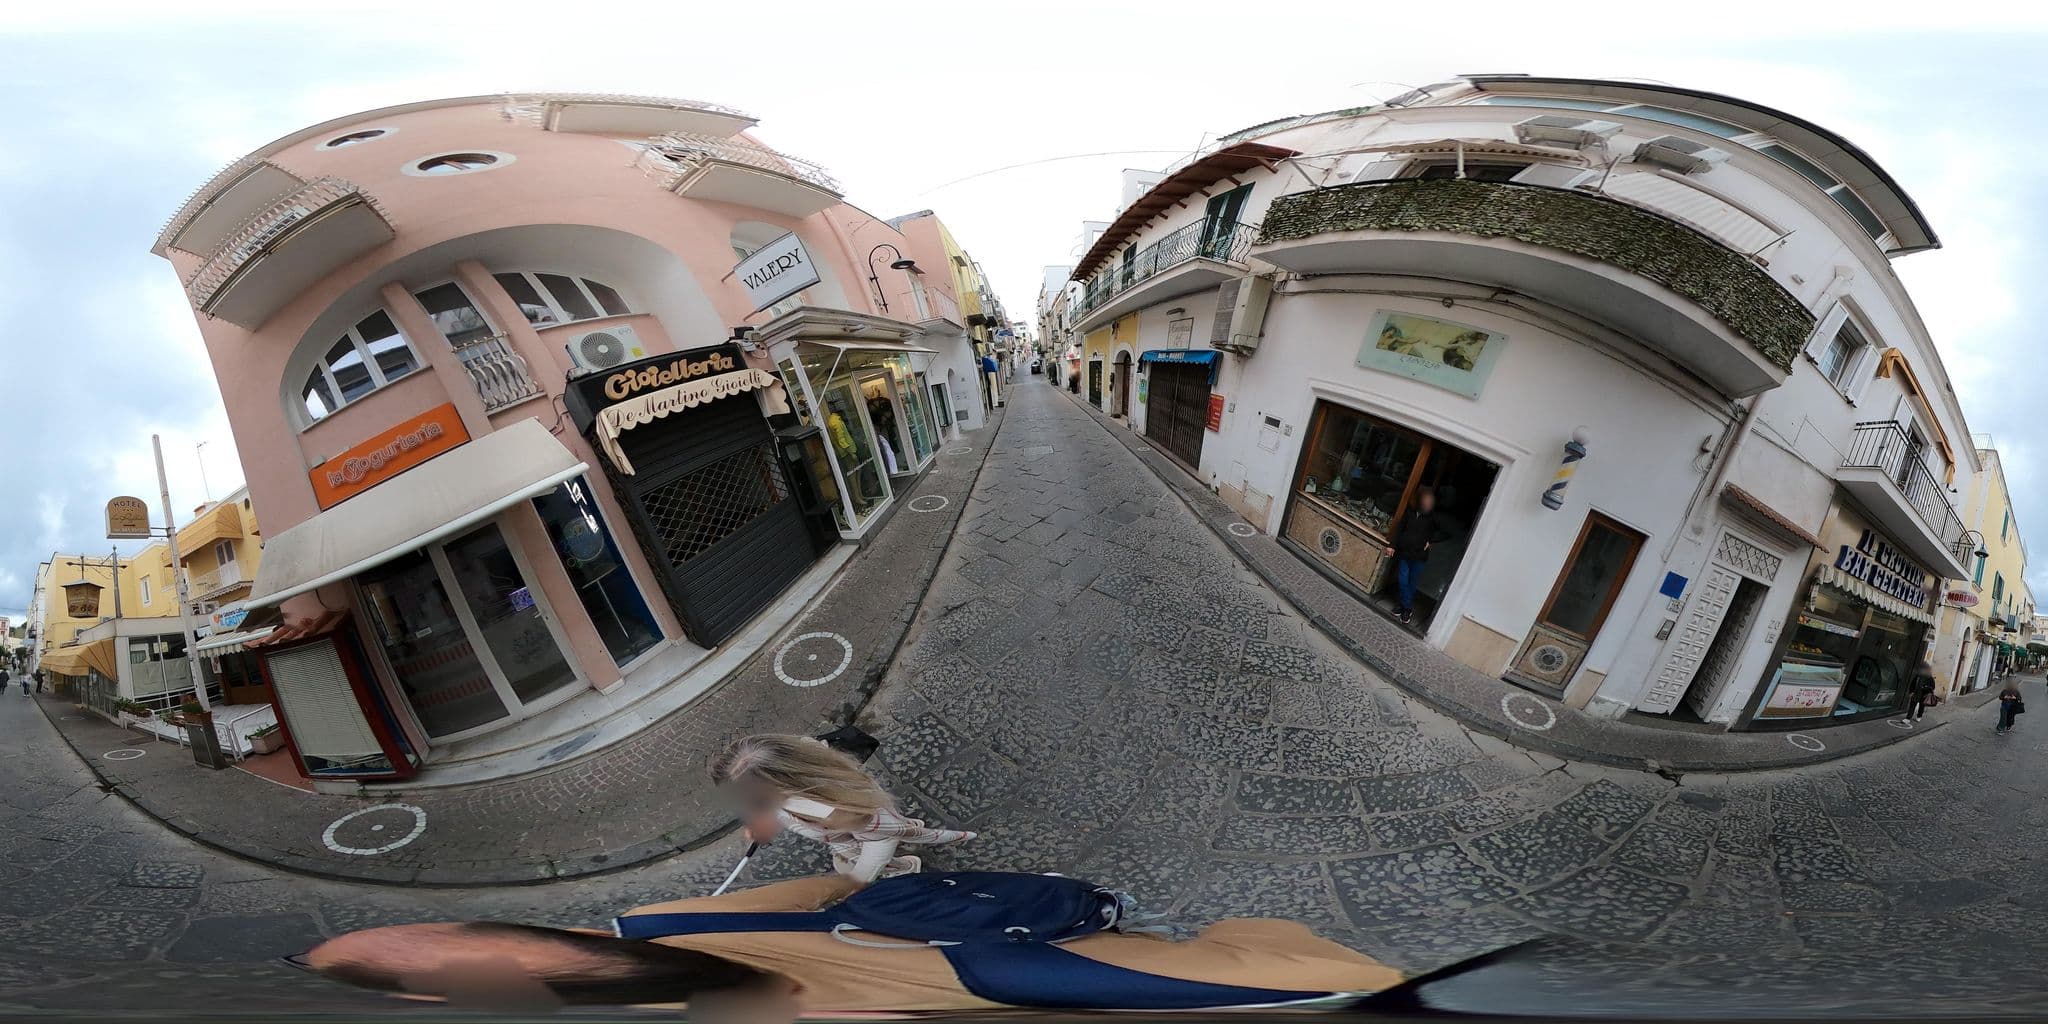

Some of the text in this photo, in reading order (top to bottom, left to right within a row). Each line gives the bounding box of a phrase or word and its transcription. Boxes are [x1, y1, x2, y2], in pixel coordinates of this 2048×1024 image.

[743, 248, 803, 290] VALERY
[604, 352, 734, 400] Gioielleria
[606, 371, 762, 429] De Martino Gioielli
[1840, 547, 1872, 584] BAR
[1947, 591, 1978, 604] MORENO
